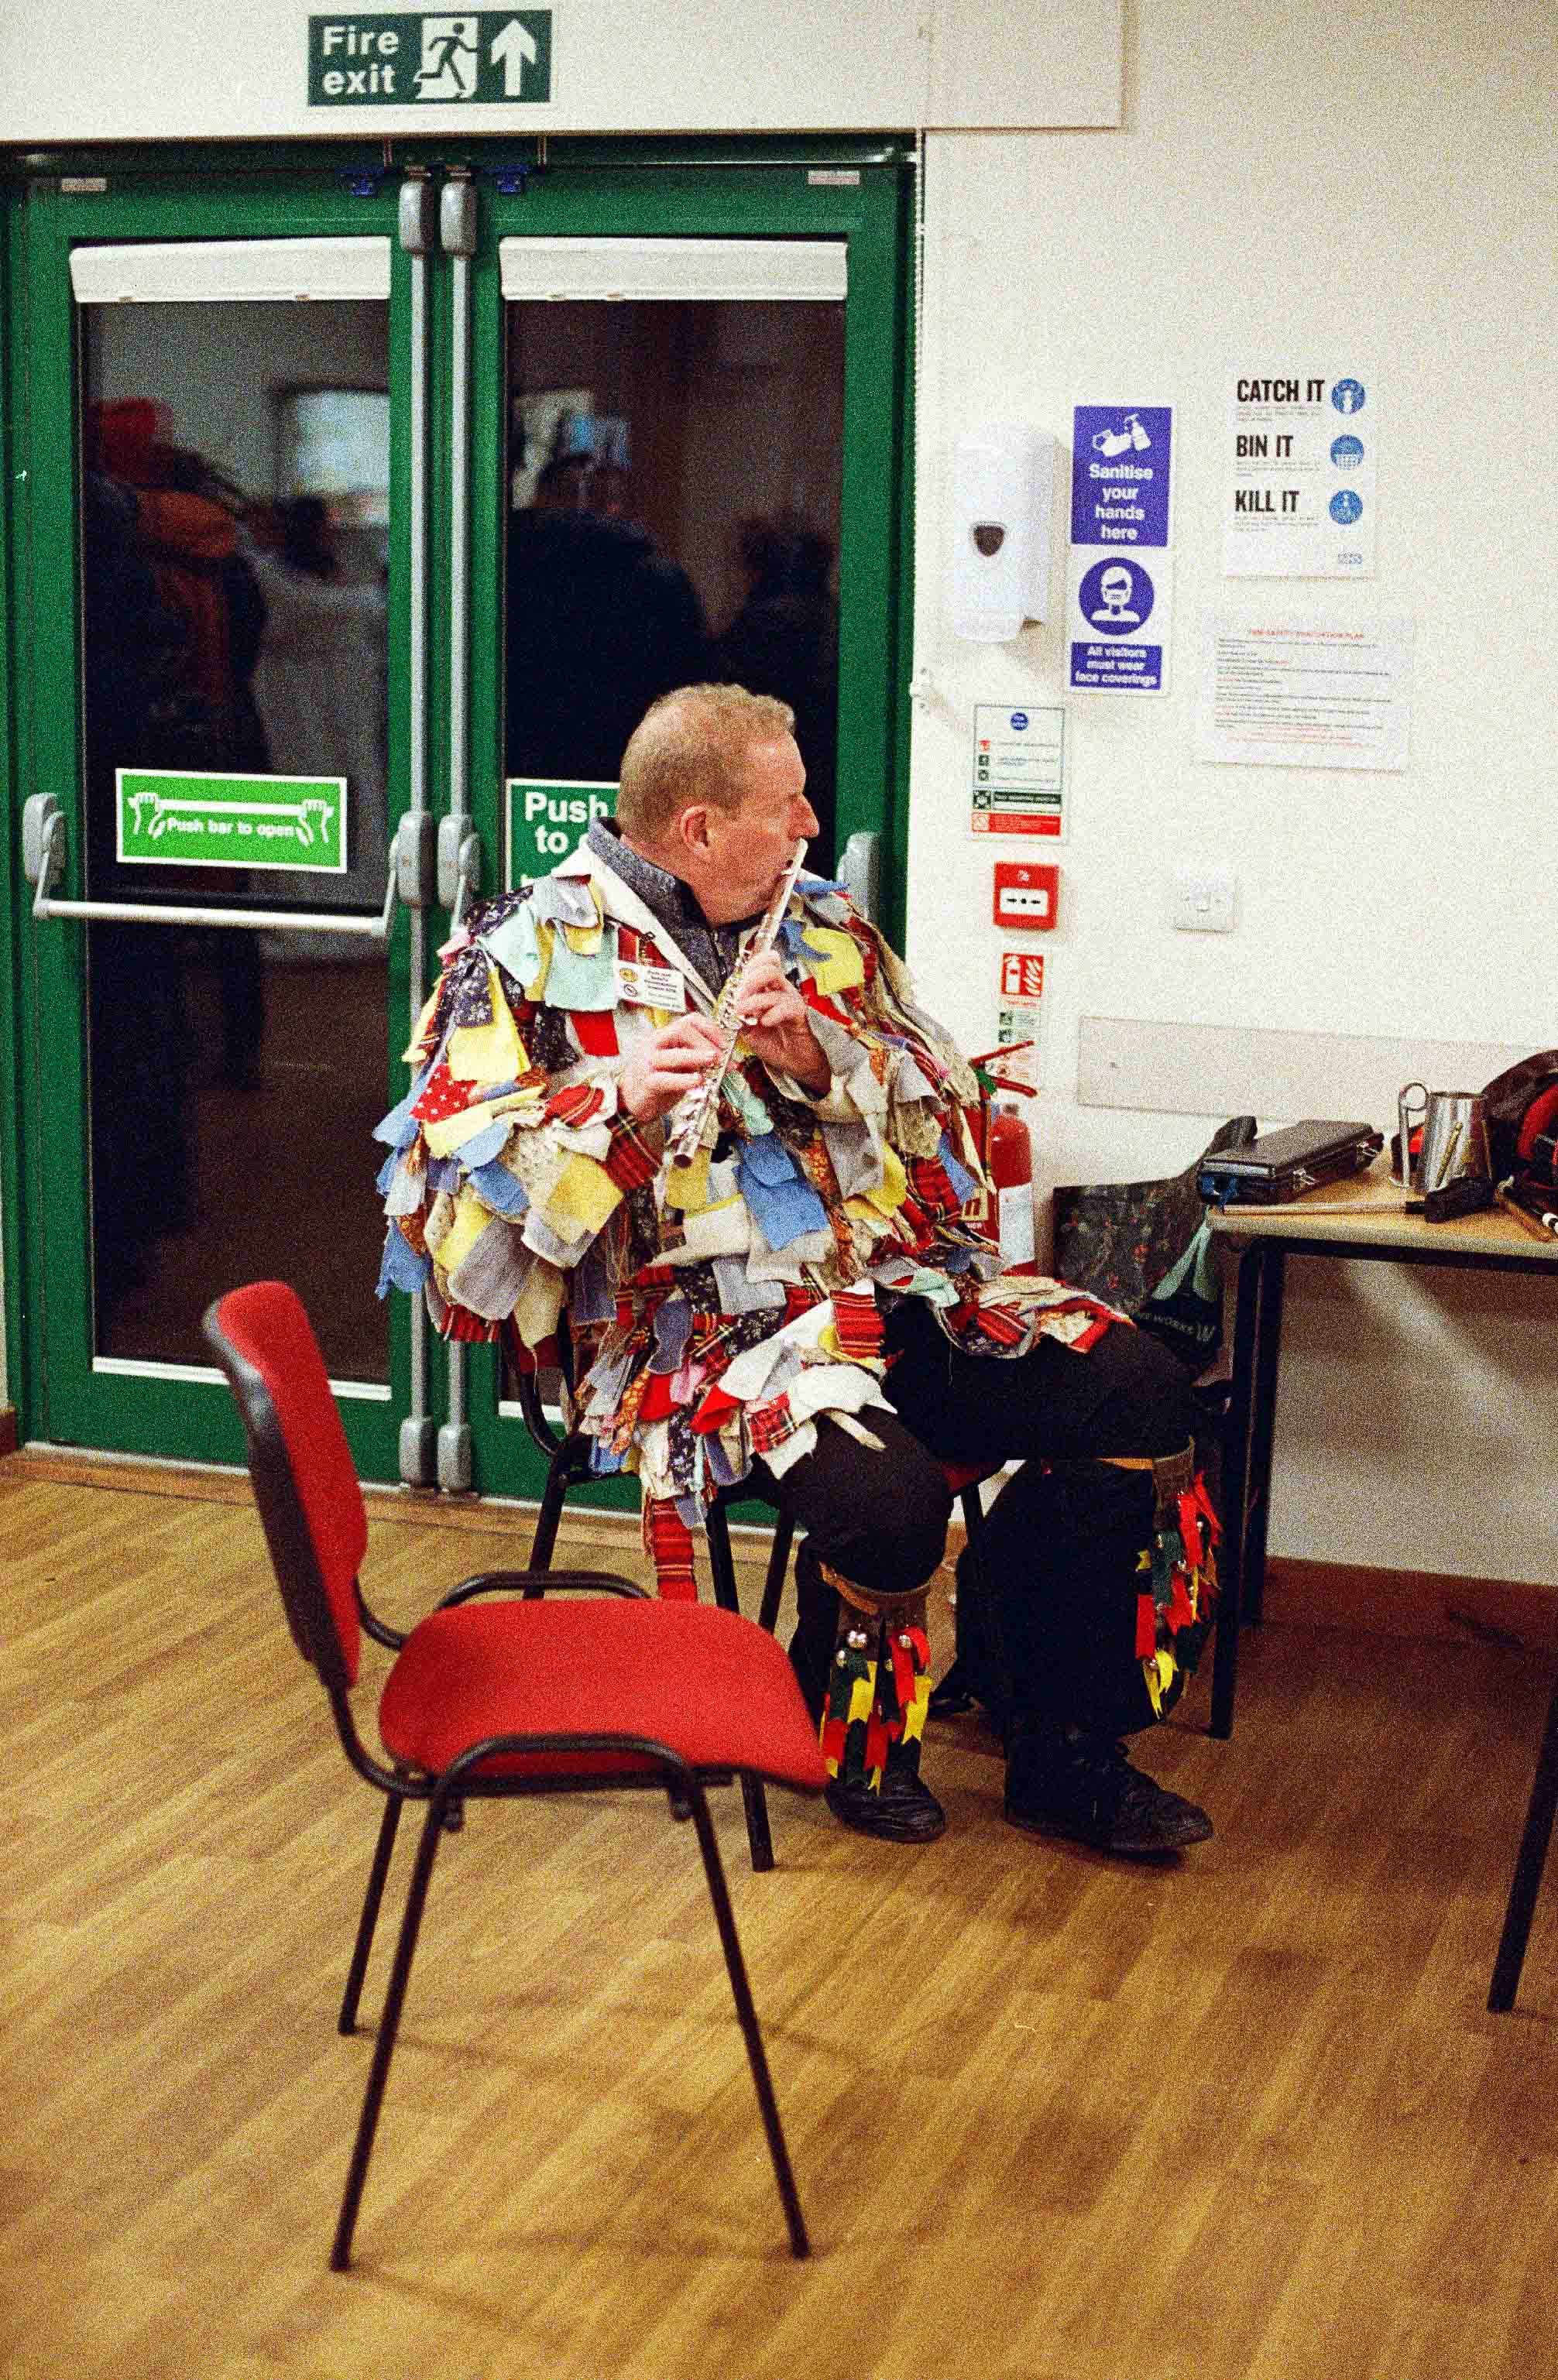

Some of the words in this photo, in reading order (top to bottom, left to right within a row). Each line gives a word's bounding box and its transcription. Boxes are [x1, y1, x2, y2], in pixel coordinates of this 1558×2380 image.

[321, 25, 400, 56] Fire
[321, 63, 397, 94] exit
[1237, 379, 1299, 402] CATCH
[1306, 379, 1326, 402] IT
[1236, 434, 1268, 458] BIN
[1275, 434, 1294, 458] IT
[1089, 464, 1154, 480] Sanitise
[1102, 486, 1139, 503] your
[1234, 489, 1276, 513] KILL
[1282, 489, 1300, 513] IT
[1094, 505, 1145, 521] hands
[1100, 525, 1138, 540] here
[1086, 646, 1103, 656] All
[1104, 647, 1147, 658] visitors
[1086, 660, 1115, 670] must
[1117, 662, 1145, 670] wear
[1102, 673, 1158, 688] coverings
[525, 791, 609, 823] Push
[167, 817, 204, 833] Push
[208, 819, 233, 834] bar
[237, 820, 253, 835] to
[256, 824, 295, 838] open
[535, 825, 569, 854] to
